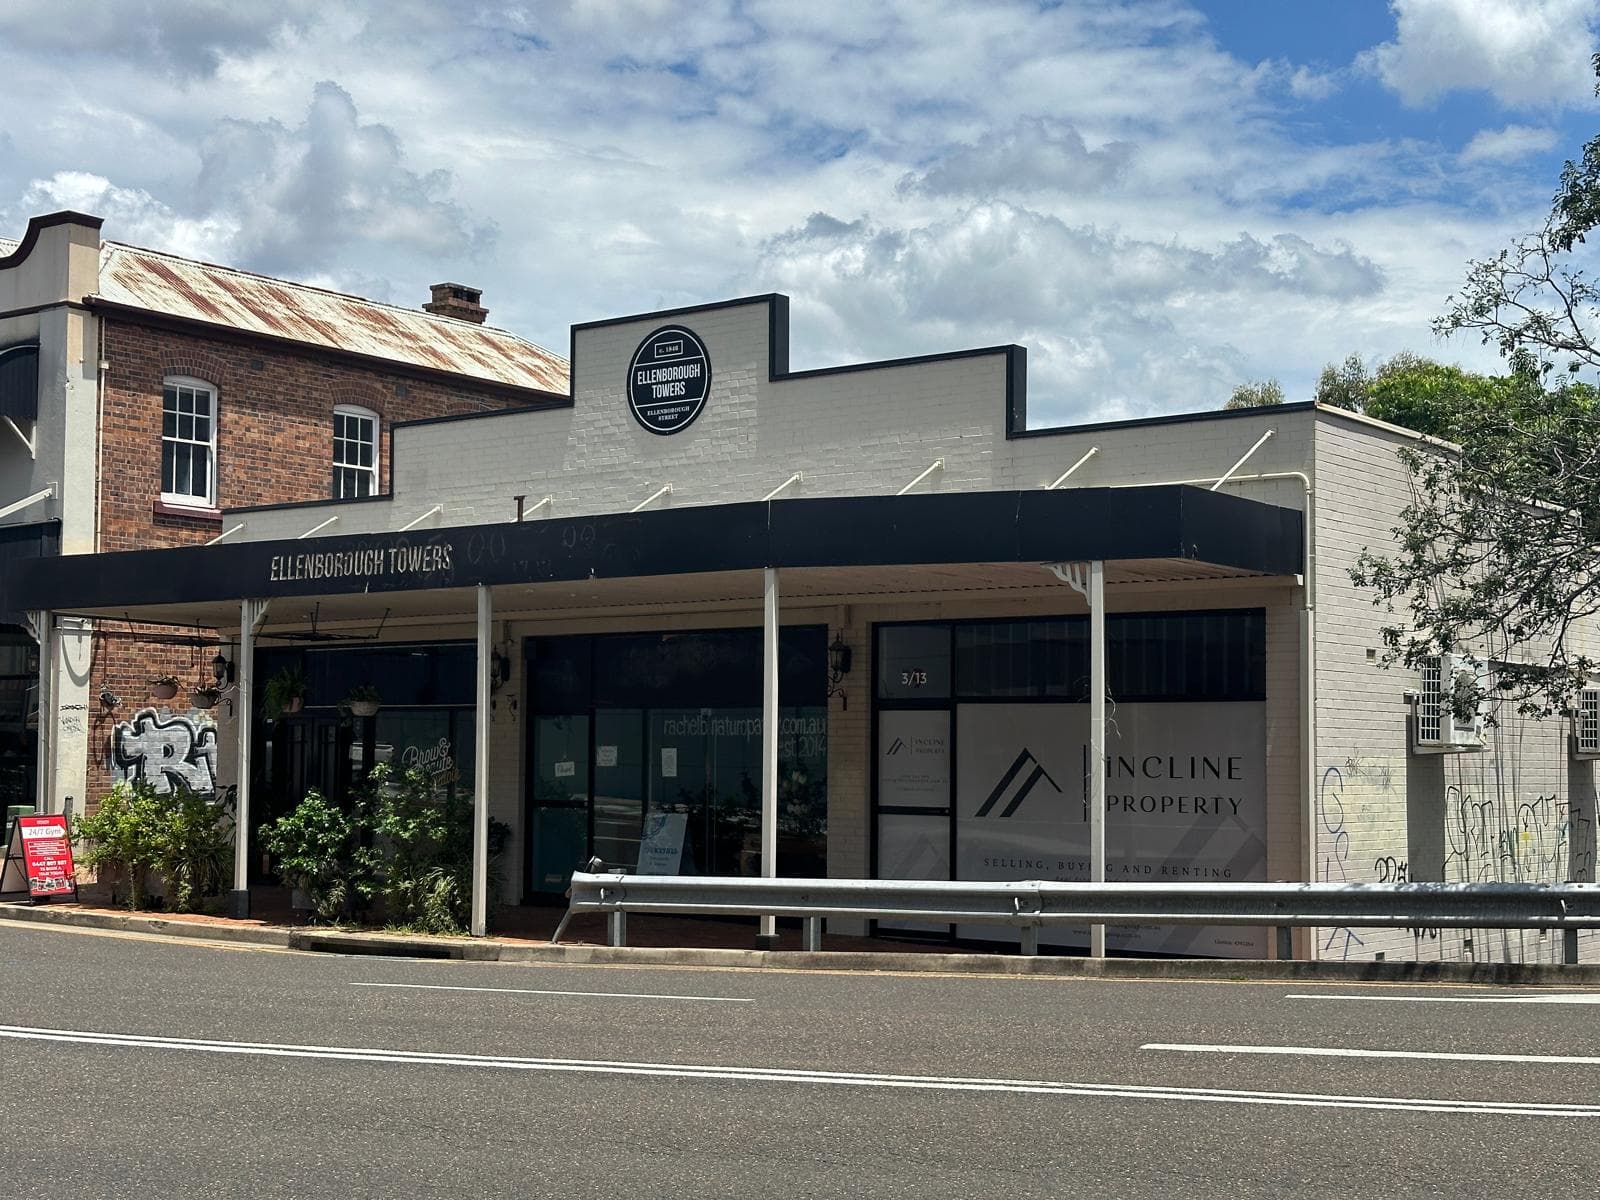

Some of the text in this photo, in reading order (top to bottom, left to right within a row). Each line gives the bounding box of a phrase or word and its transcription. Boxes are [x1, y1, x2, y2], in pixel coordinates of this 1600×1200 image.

[637, 363, 701, 385] ELLENBOROUGH
[652, 381, 686, 399] TOWERS
[647, 406, 690, 416] ELLENBOROUGH
[658, 413, 679, 421] STREET
[270, 544, 452, 581] ELLENBOROUGH TOWERS
[901, 671, 927, 686] 3/13
[1106, 755, 1243, 780] INCLINE
[1106, 795, 1243, 816] PROPERTY
[29, 828, 44, 837] 24/7
[983, 857, 1049, 870] SELLING,
[1122, 864, 1152, 874] AND
[1161, 866, 1232, 879] RENTING
